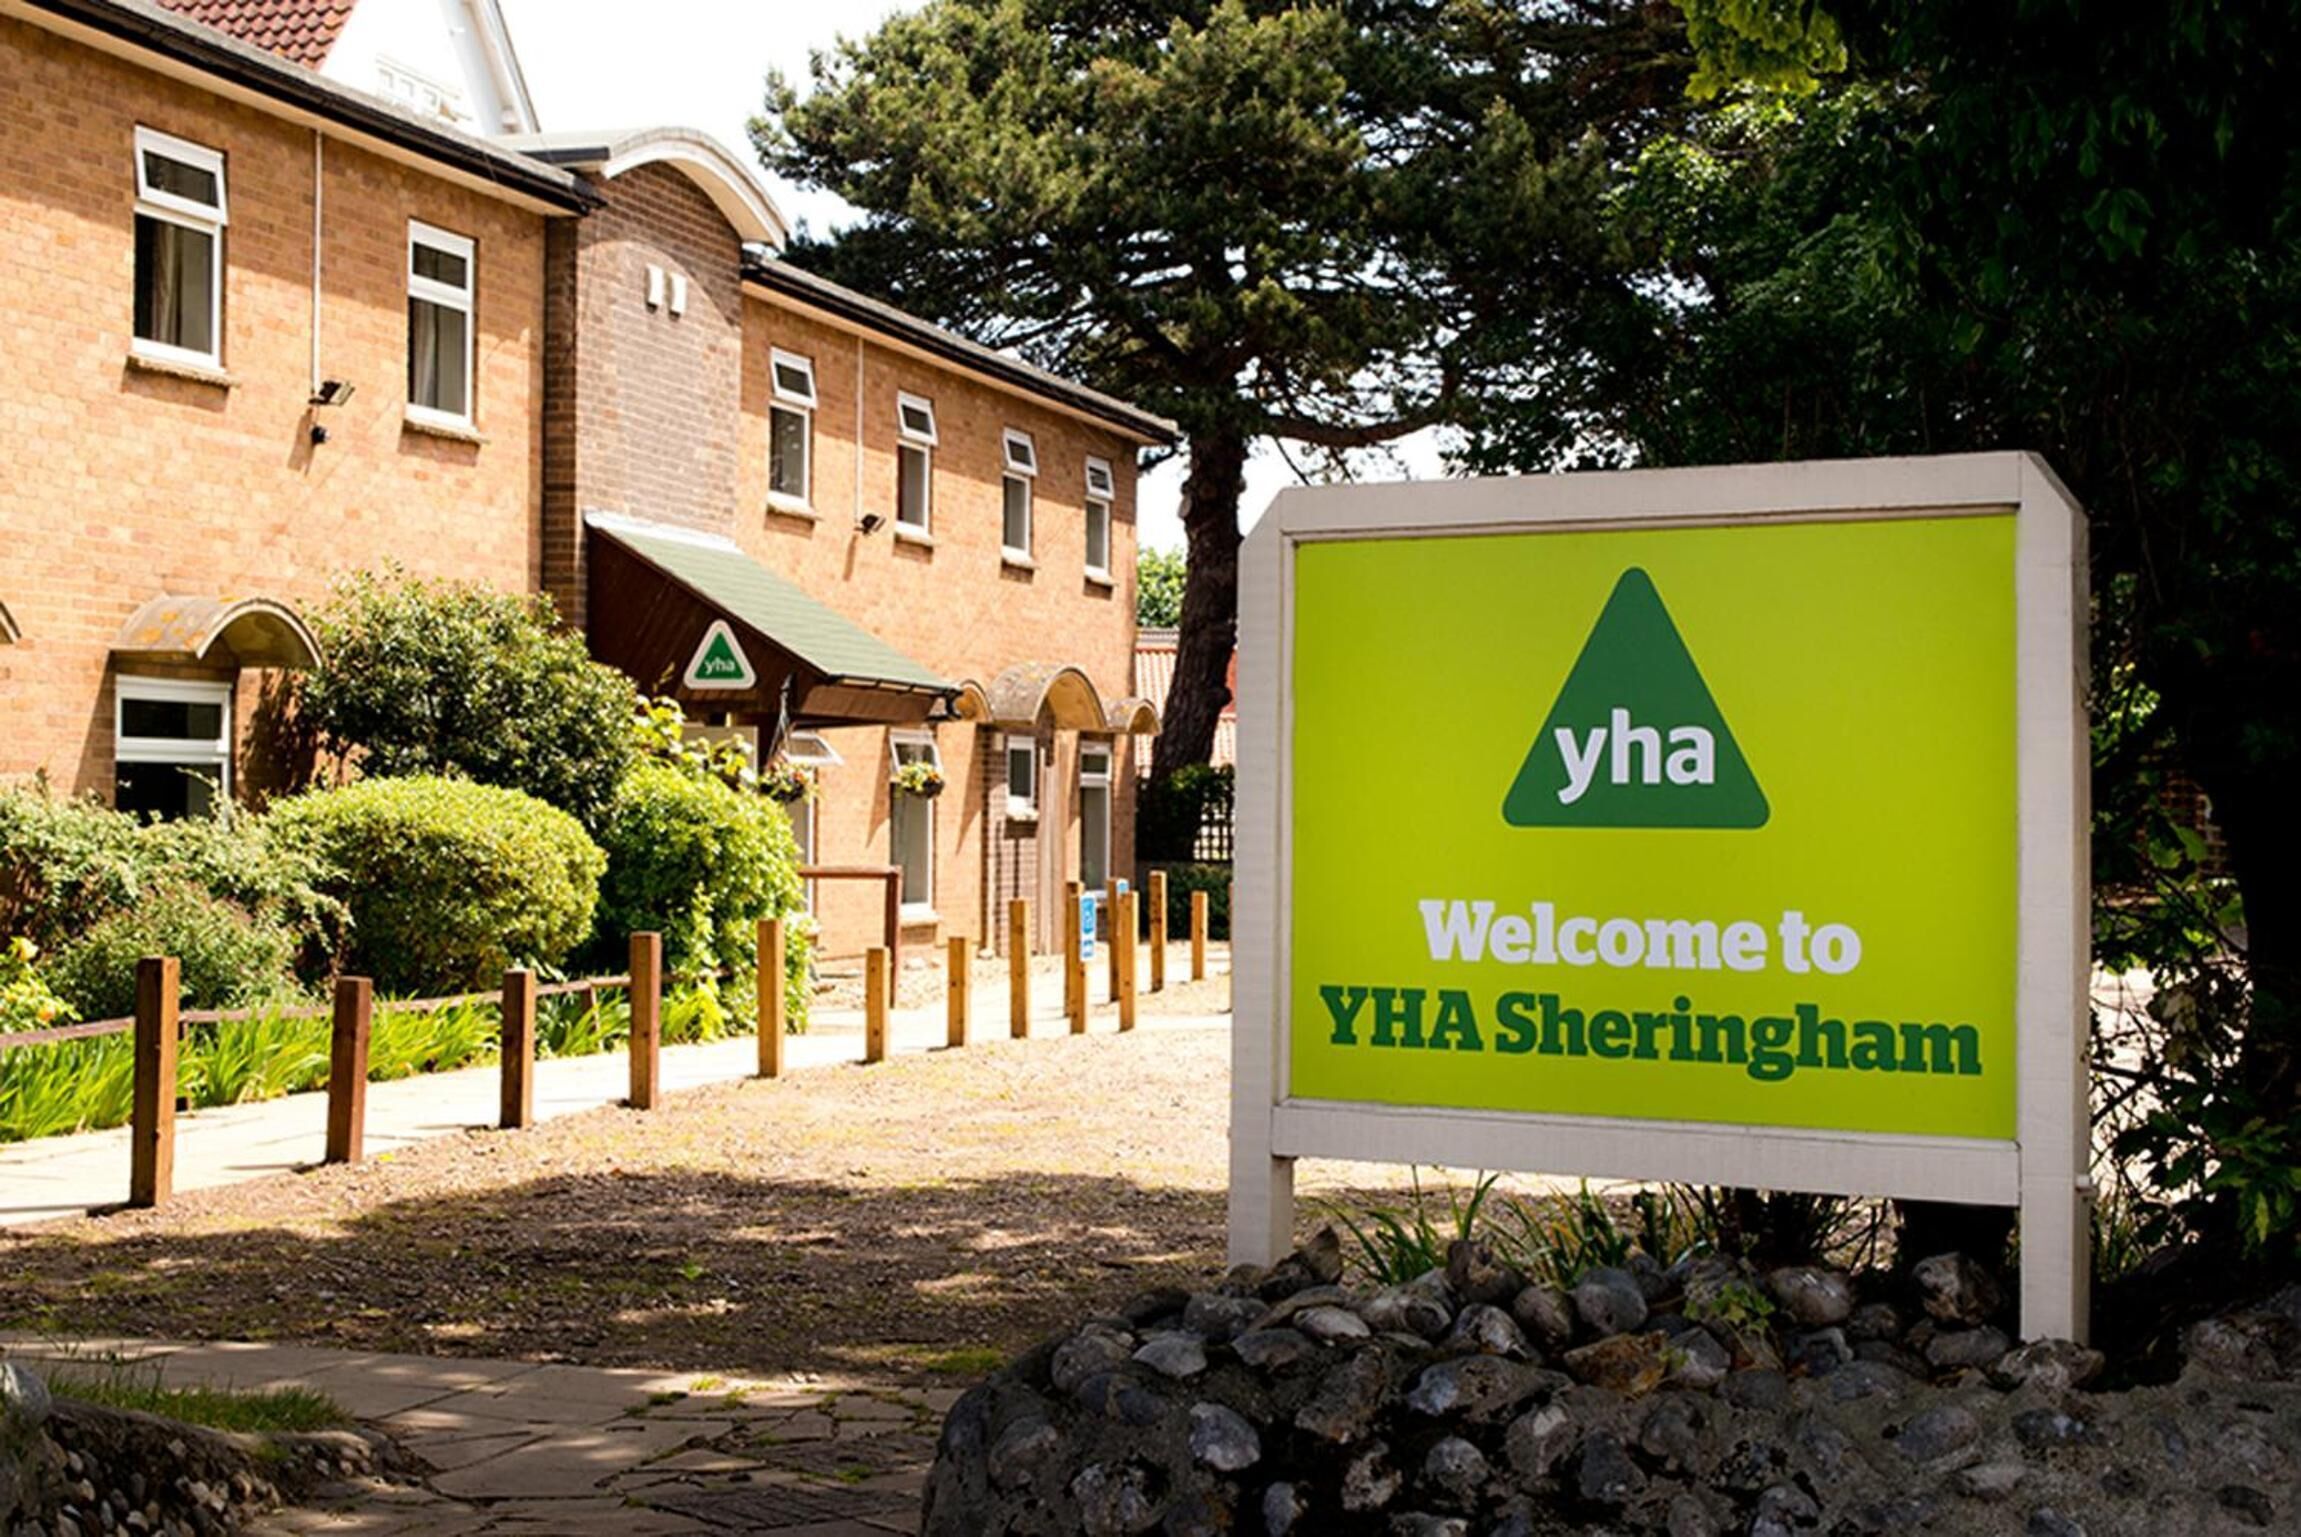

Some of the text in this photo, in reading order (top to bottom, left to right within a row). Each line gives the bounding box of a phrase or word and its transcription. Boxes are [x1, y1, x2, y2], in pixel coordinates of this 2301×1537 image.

[704, 657, 735, 675] yha
[1554, 708, 1716, 805] yha
[1418, 899, 1862, 975] Welcome to
[1319, 985, 1983, 1082] YHA Sheringham
